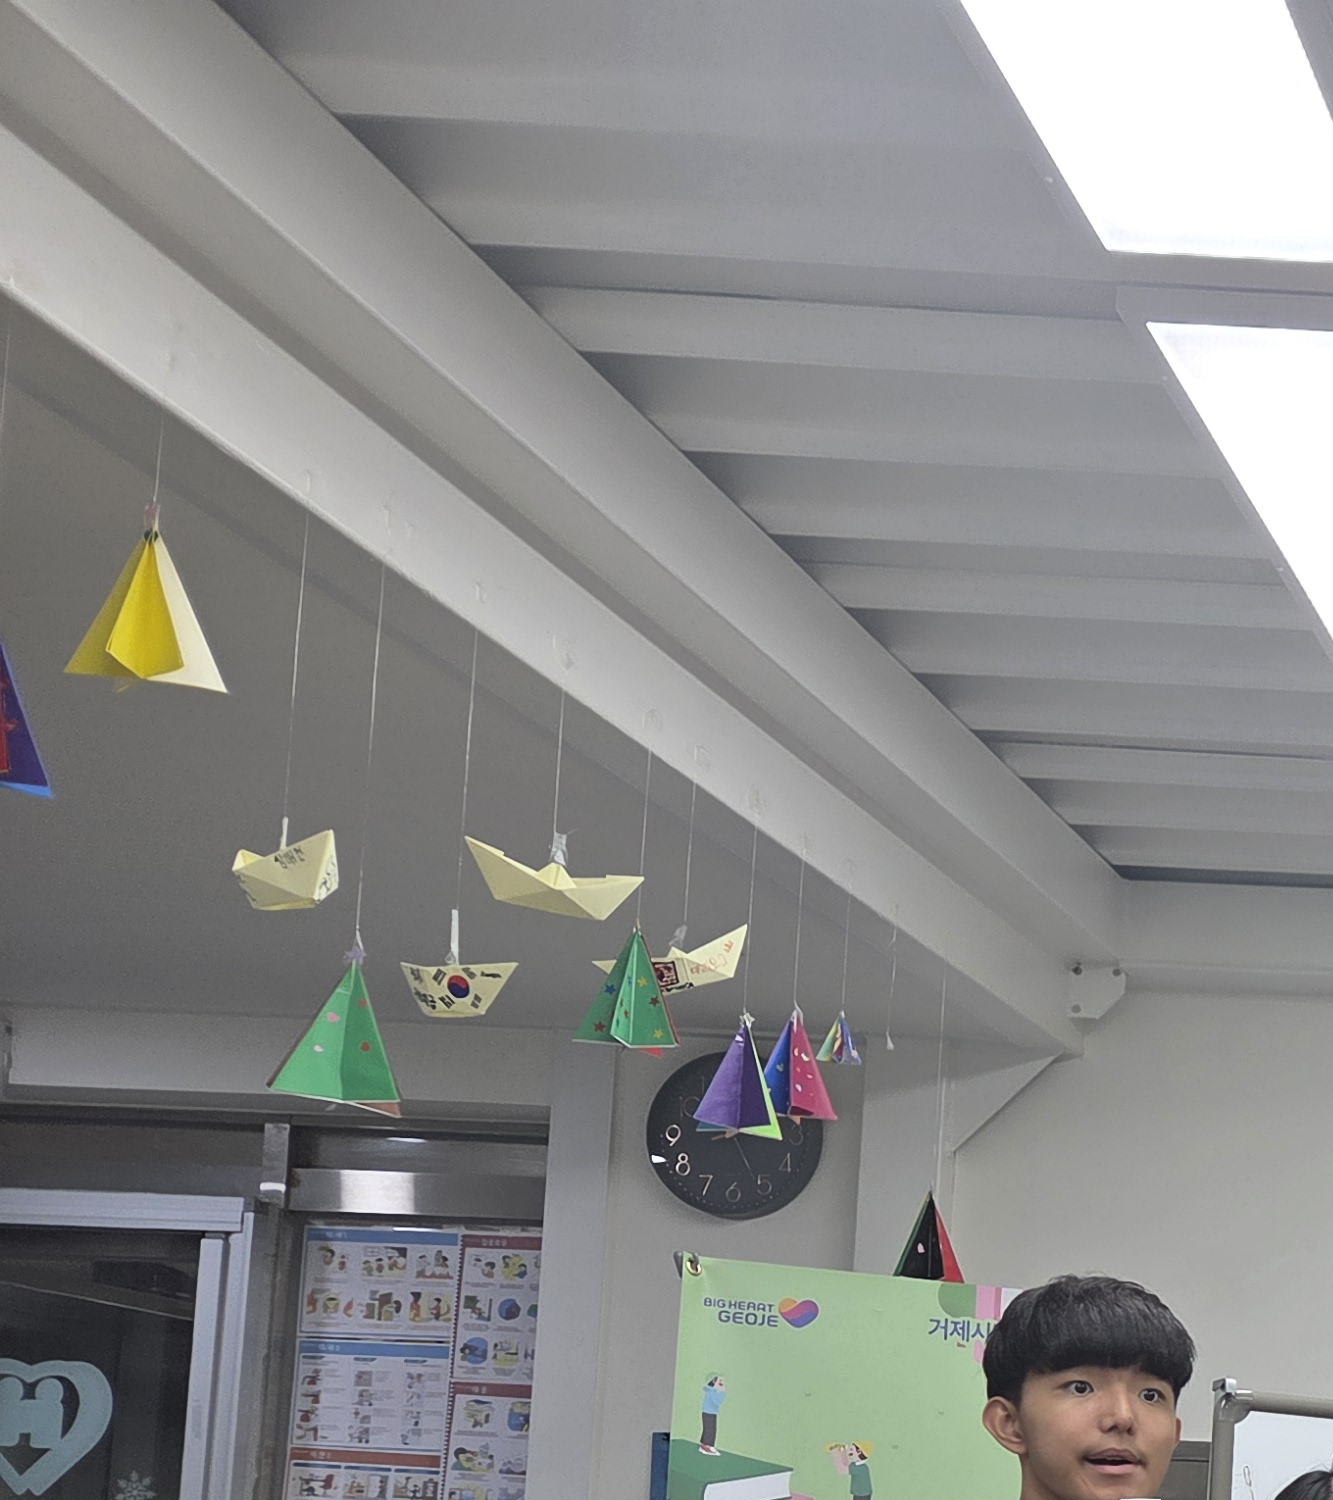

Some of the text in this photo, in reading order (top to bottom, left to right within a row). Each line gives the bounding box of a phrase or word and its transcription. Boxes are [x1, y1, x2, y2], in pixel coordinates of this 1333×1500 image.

[665, 1124, 682, 1146] 9
[675, 1153, 691, 1176] 8
[778, 1152, 792, 1174] 4
[699, 1174, 713, 1196] 7
[725, 1182, 742, 1202] 6
[756, 1174, 772, 1196] 5
[703, 1297, 775, 1313] BIG HEART
[717, 1311, 779, 1328] GEOJE
[928, 1317, 998, 1342] 거제시
